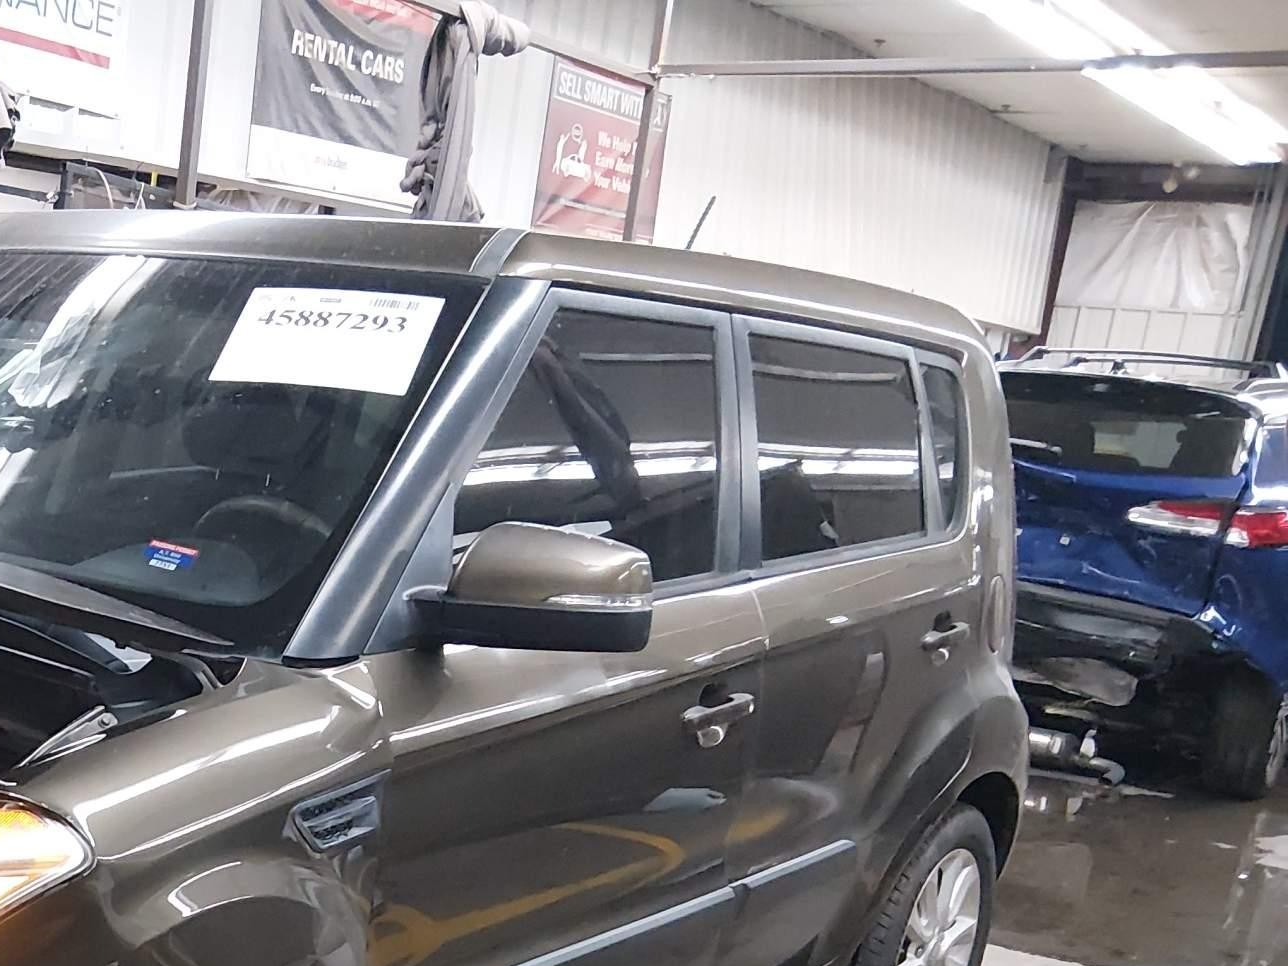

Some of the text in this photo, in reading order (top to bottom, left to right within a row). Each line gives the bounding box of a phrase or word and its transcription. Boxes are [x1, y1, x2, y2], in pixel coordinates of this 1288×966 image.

[291, 29, 405, 83] RENTAL CARS
[559, 71, 582, 100] SELL
[583, 81, 619, 112] SMART
[620, 93, 643, 119] WIT
[258, 309, 408, 333] 45887293
